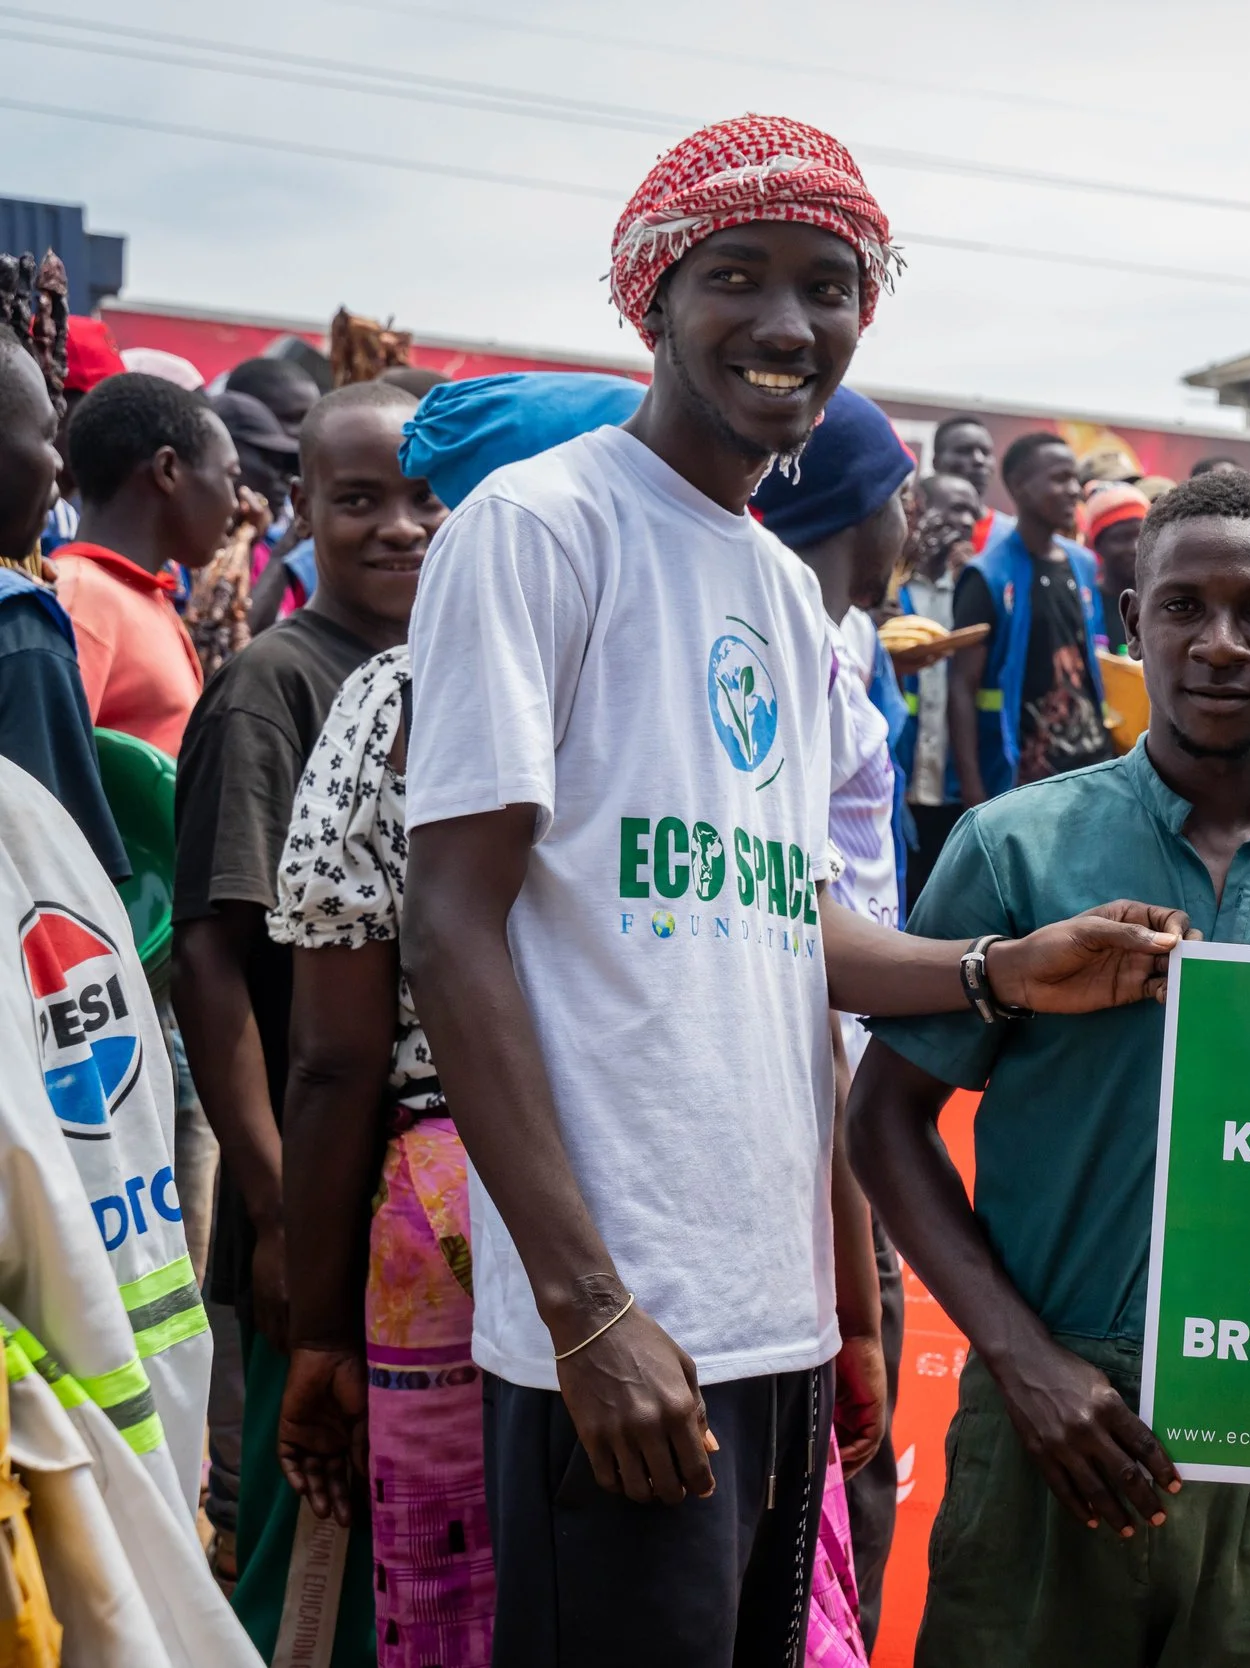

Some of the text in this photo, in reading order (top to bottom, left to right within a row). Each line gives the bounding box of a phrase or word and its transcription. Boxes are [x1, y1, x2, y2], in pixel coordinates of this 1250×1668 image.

[619, 816, 818, 925] ECO SPACE
[291, 1574, 328, 1661] EDUCATION
